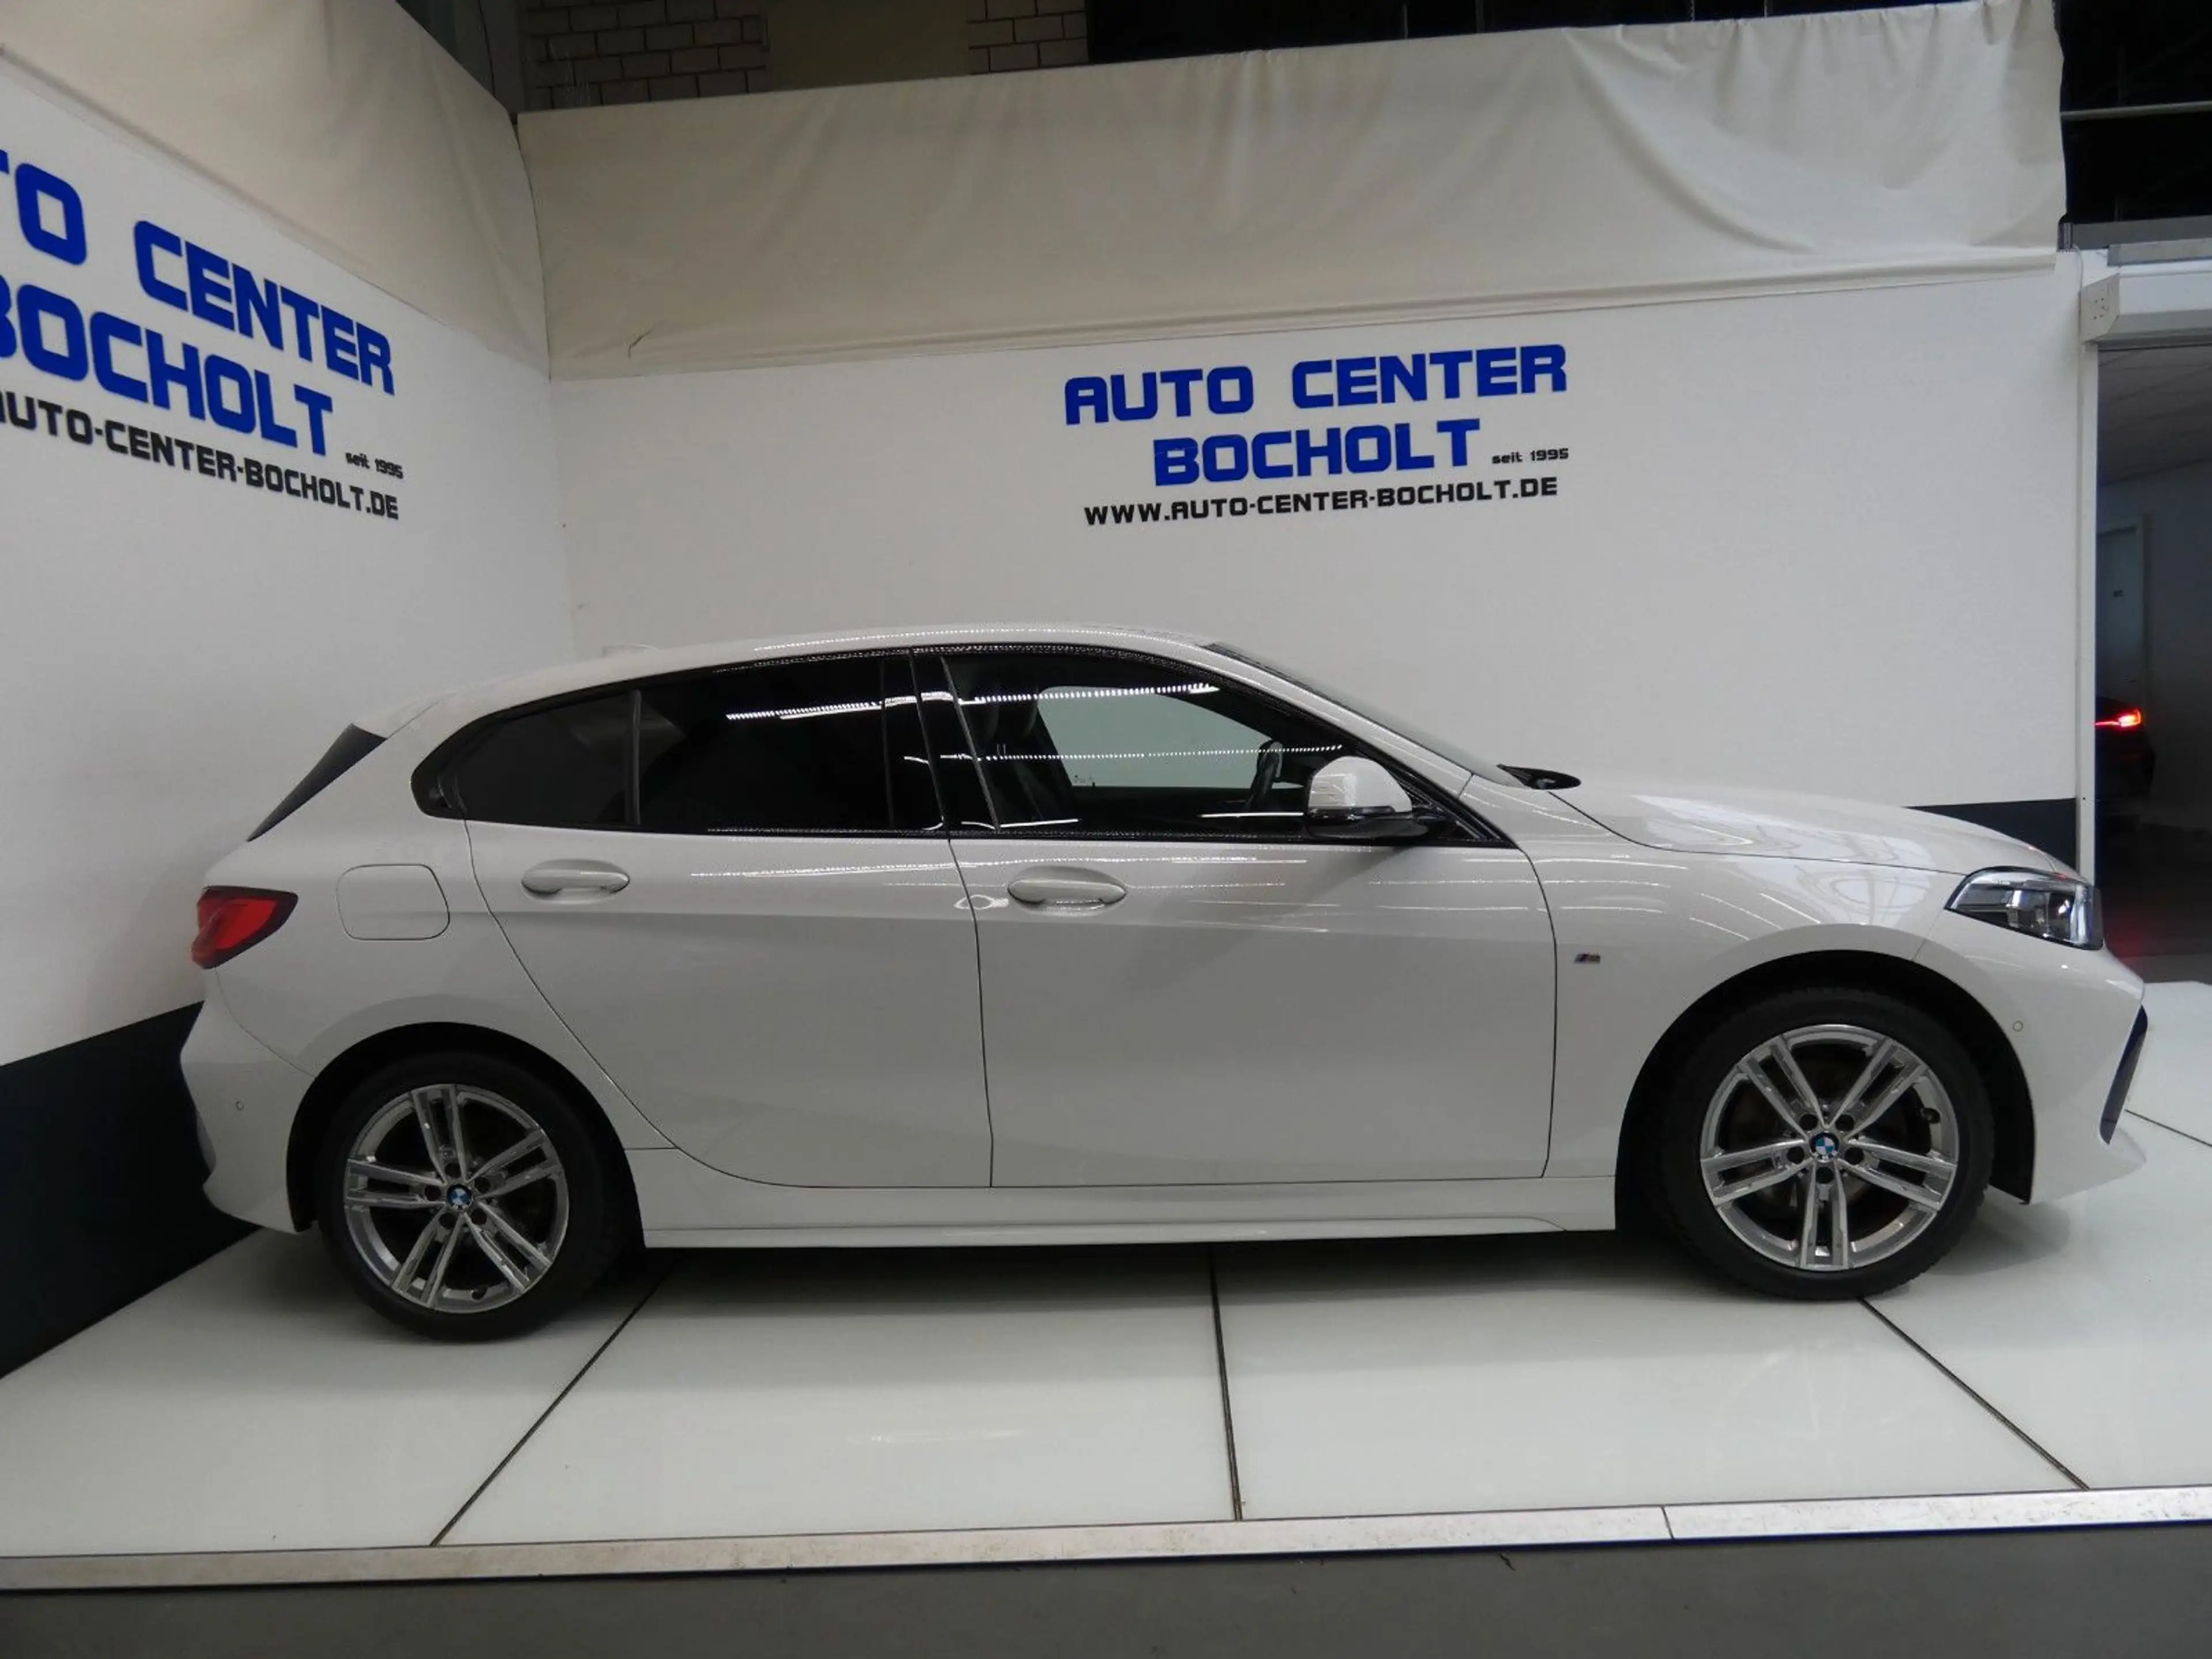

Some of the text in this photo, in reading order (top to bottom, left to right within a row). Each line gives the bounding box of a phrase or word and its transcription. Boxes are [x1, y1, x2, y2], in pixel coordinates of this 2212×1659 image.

[0, 149, 395, 396] O CENTER
[1065, 344, 1567, 425] AUTO CENTER
[0, 390, 399, 520] UTO-CENTER-BOCHOLT.DE
[374, 457, 404, 479] 1995
[1153, 419, 1481, 487] BOCHOLT
[1492, 447, 1569, 464] seit 1995
[1084, 477, 1558, 525] WWW.AUTO-CENTER-BOCHOLT.DE
